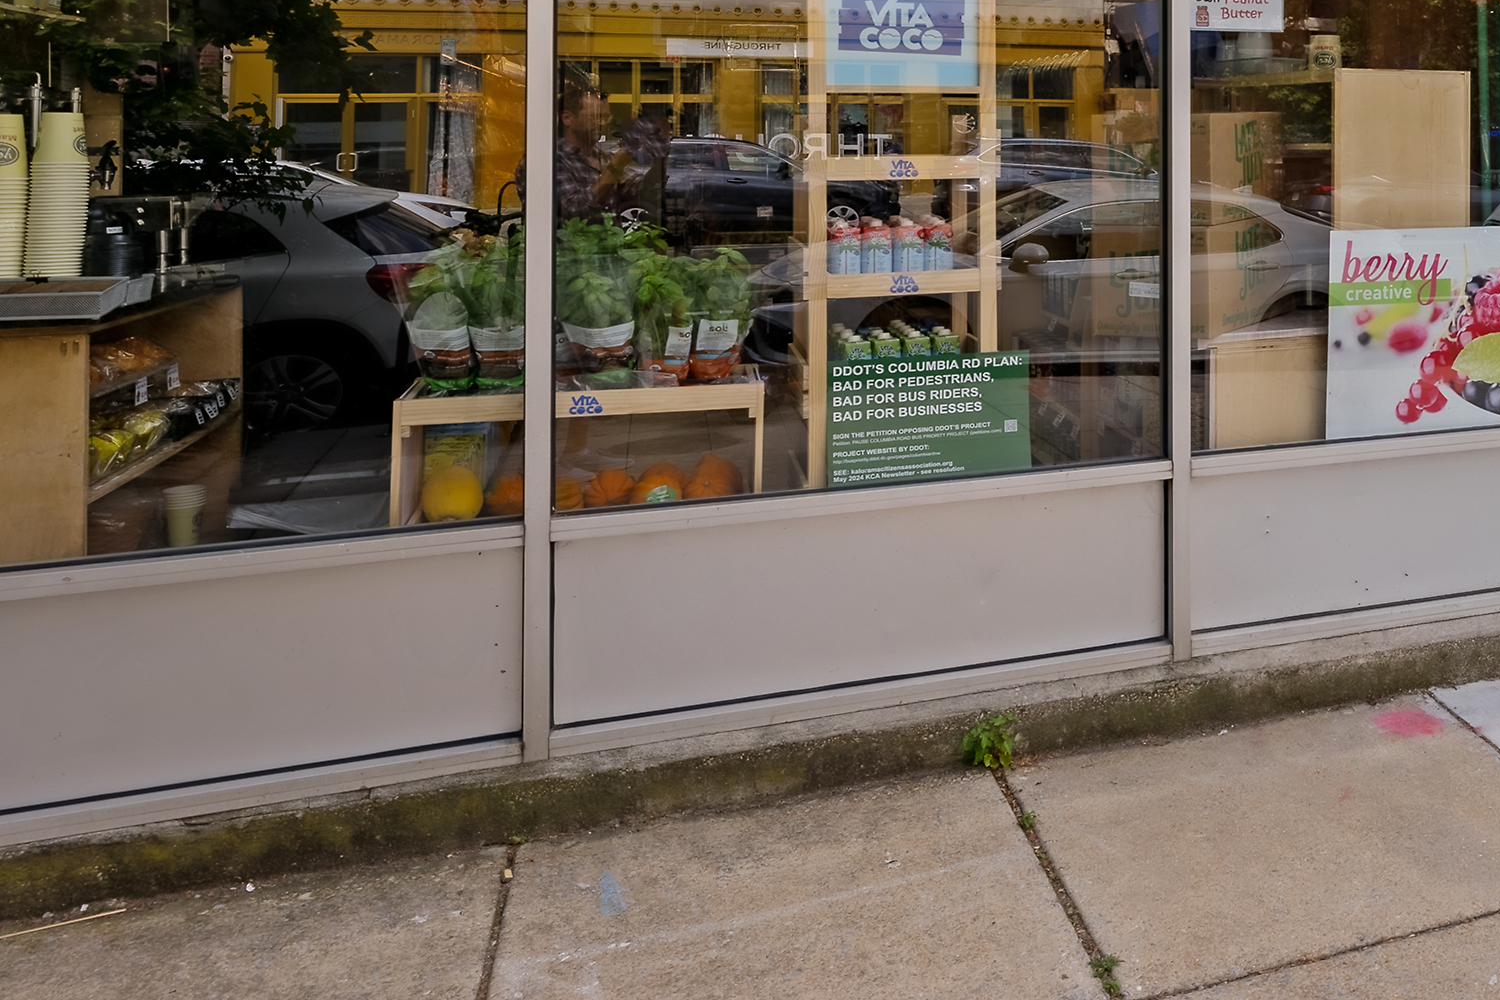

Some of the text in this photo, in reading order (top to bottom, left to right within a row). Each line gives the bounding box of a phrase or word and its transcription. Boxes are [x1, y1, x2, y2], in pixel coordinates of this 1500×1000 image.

[1220, 6, 1263, 20] Butter
[859, 27, 944, 51] COCO
[891, 159, 916, 169] VITA
[889, 169, 919, 178] COCO
[891, 275, 916, 285] VITA
[1341, 240, 1448, 306] berry
[889, 284, 919, 293] COCO
[1345, 284, 1412, 302] creative
[833, 355, 1023, 377] DDOT'S COLUMBIA RD PLAN:
[833, 372, 994, 392] BAD FOR PEDESTRIANS,
[571, 395, 599, 406] VITA
[833, 387, 982, 407] BAD FOR BUS RIDERS,
[569, 405, 603, 415] COCO
[833, 402, 983, 422] BAD FOR BUSINESSES
[866, 429, 897, 437] PETITION
[898, 426, 934, 434] OPPOSING
[960, 421, 991, 429] PROJECT
[833, 449, 866, 458] PROJECT
[866, 447, 897, 455] WEBSITE
[898, 445, 908, 453] BY
[848, 474, 864, 482] 2024
[881, 470, 915, 478] Newsletter
[932, 466, 965, 474] resolution
